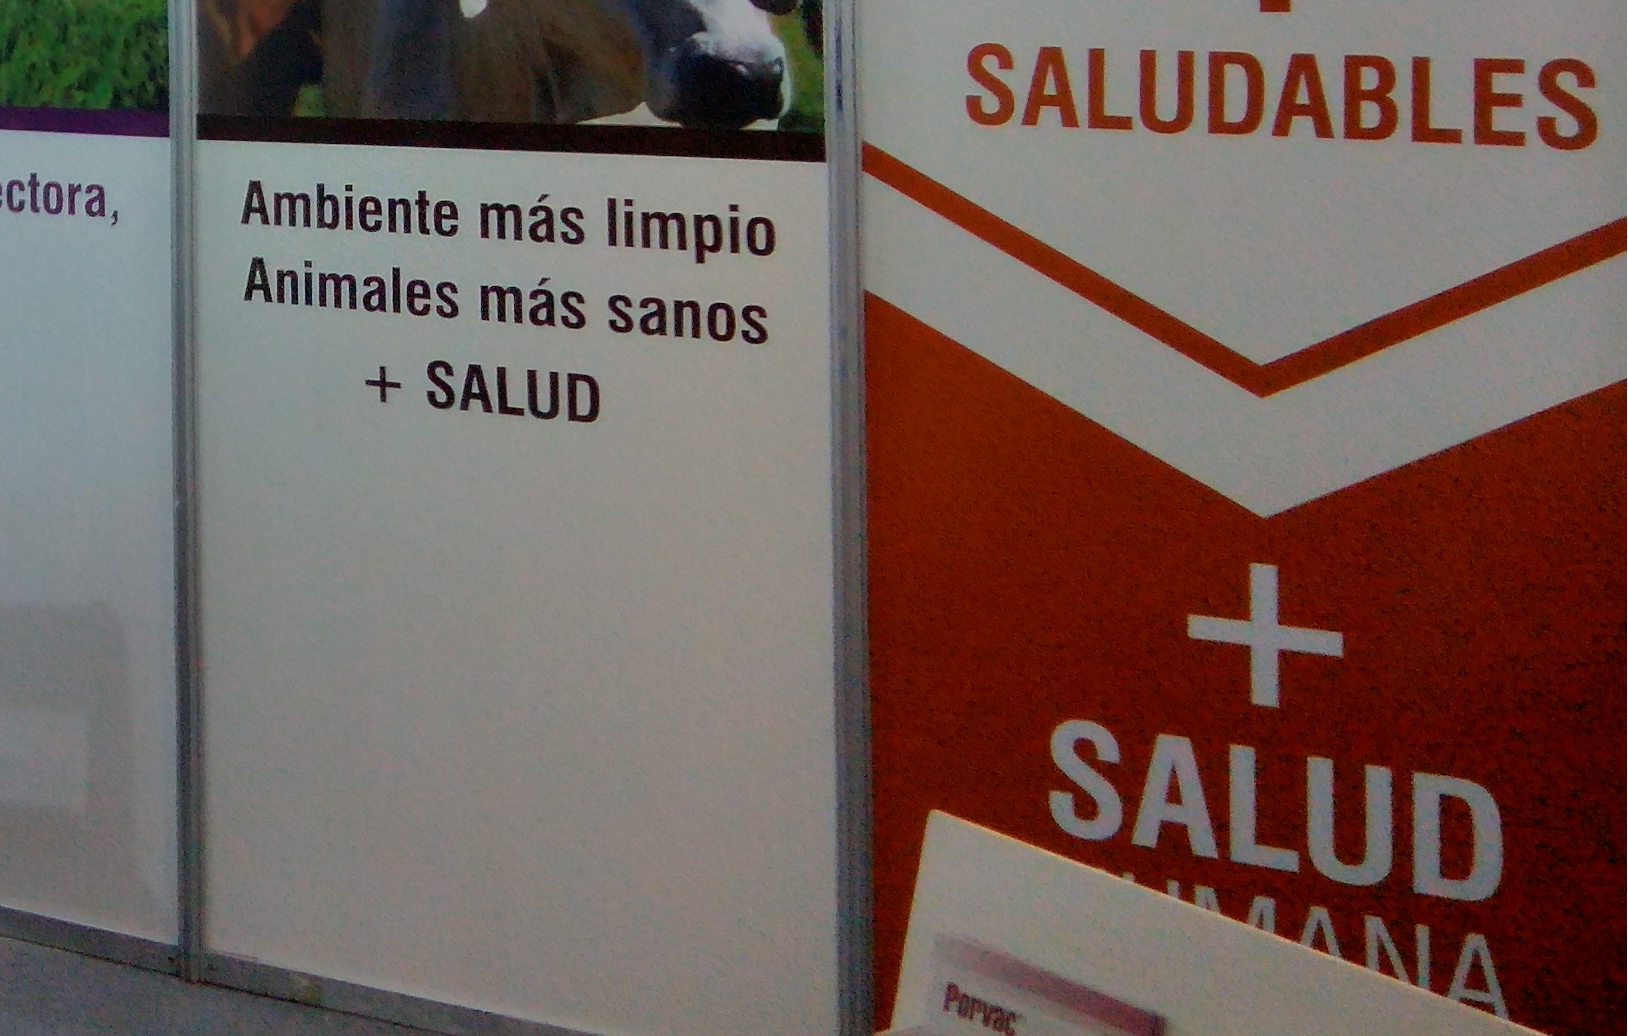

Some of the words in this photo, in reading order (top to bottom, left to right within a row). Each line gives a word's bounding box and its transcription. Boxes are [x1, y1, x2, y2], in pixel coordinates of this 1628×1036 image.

[965, 42, 1598, 151] SALUDABLES
[241, 180, 459, 237] Ambiente
[479, 194, 585, 246] más
[607, 197, 776, 264] limpio
[243, 256, 459, 319] Animales
[479, 277, 586, 329] más
[608, 294, 768, 345] sanos
[426, 360, 600, 423] SALUD
[1048, 719, 1504, 901] SALUD
[1120, 873, 1509, 1020] ANA
